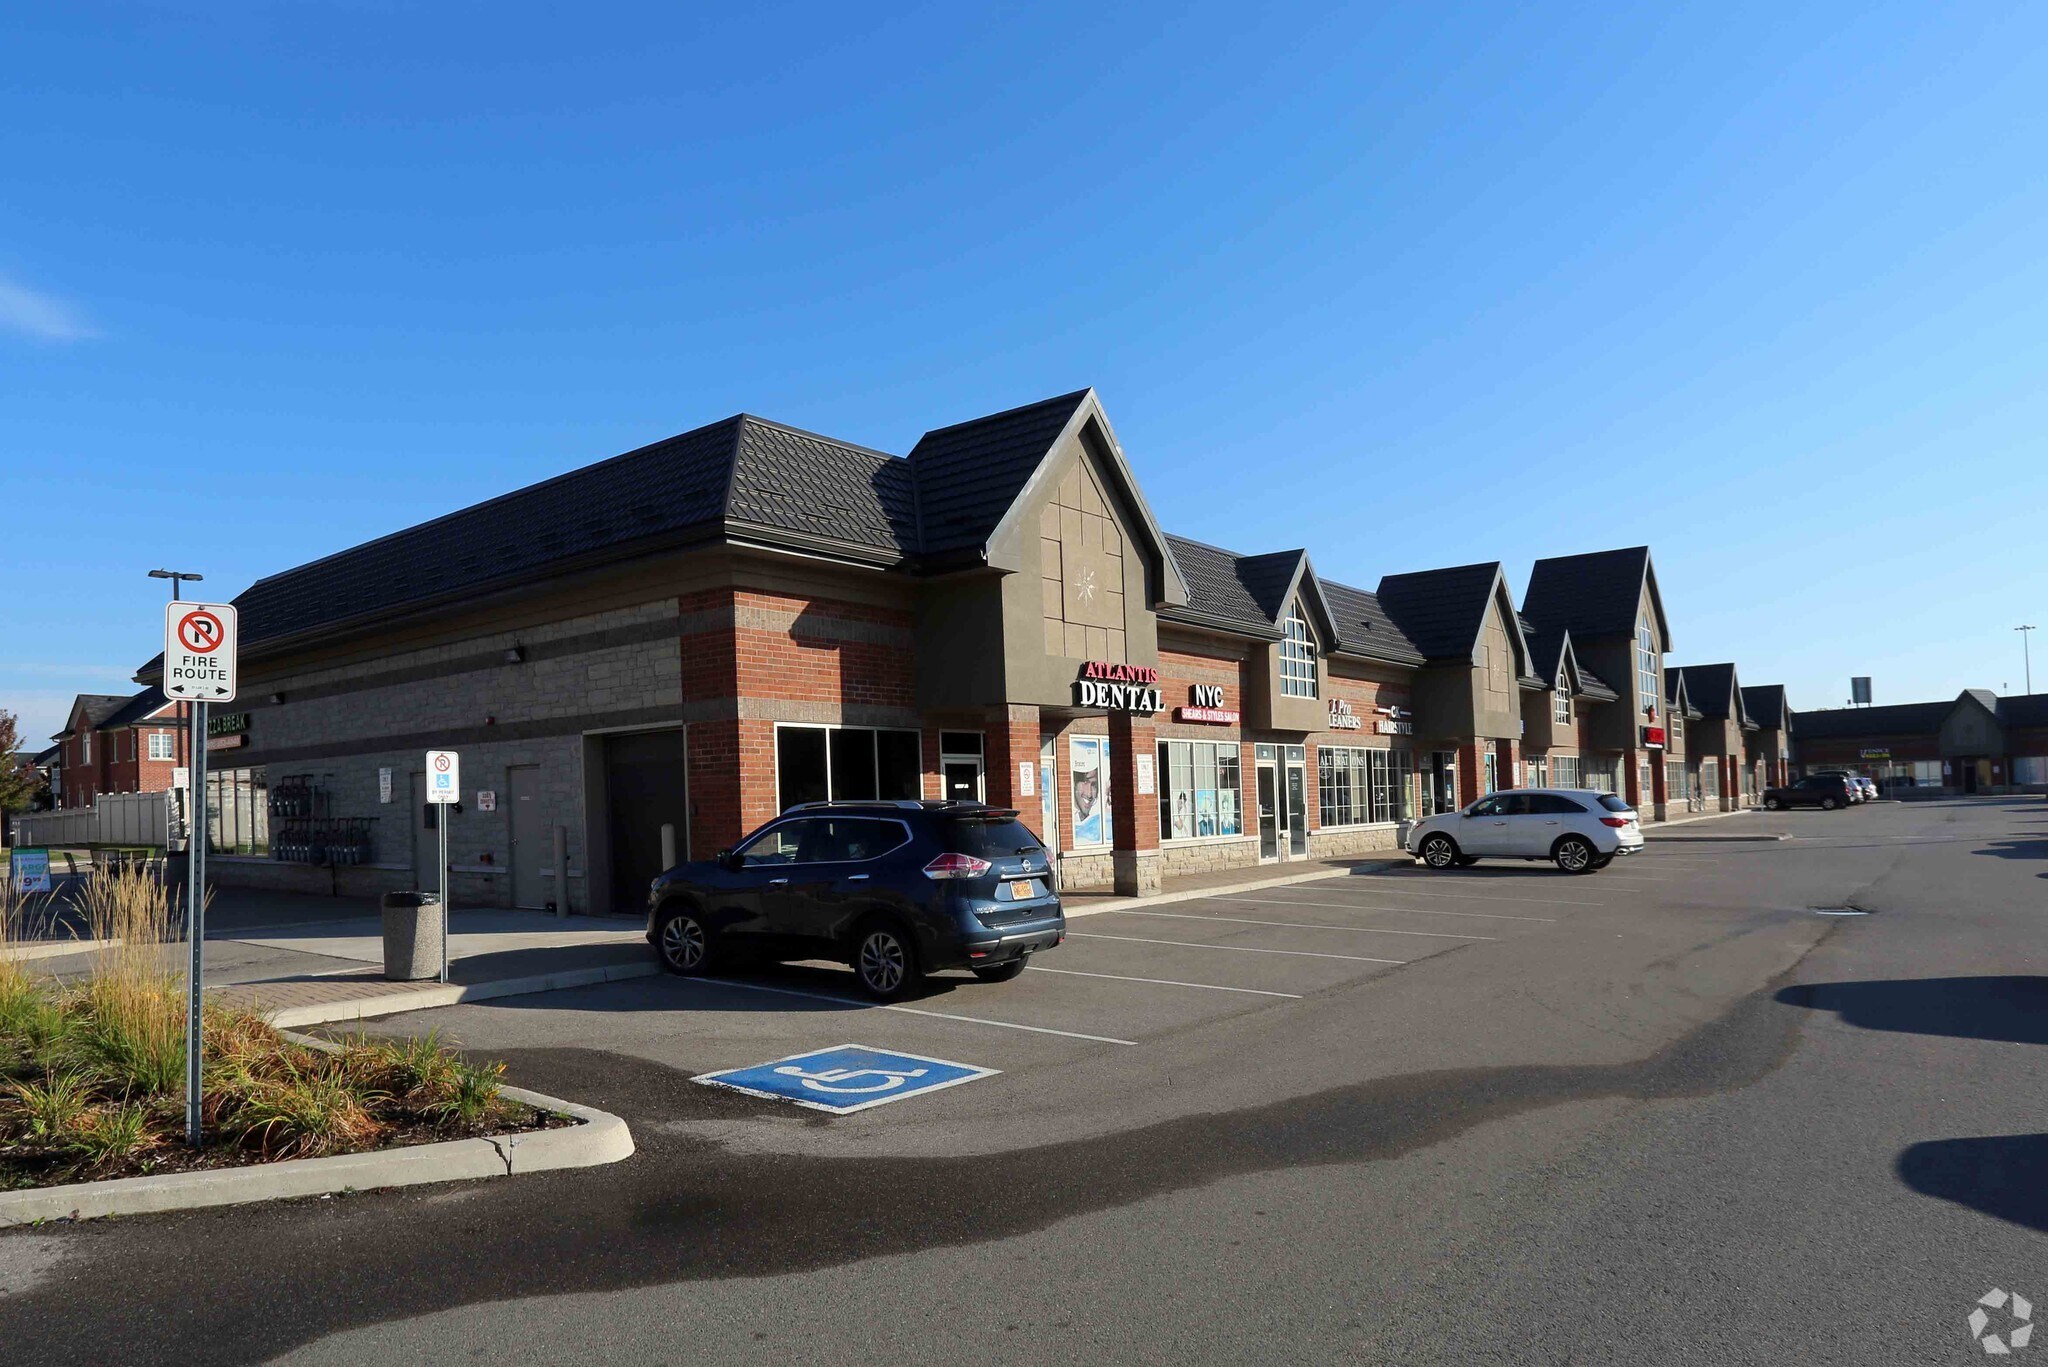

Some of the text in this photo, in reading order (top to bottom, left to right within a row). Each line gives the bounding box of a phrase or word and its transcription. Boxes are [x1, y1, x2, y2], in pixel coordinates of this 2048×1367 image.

[182, 655, 218, 668] FIRE
[173, 667, 227, 680] ROUTE
[1085, 661, 1159, 684] ATLANTIS
[1079, 680, 1167, 713] DENTAL
[1195, 684, 1224, 708] NYC
[1338, 700, 1352, 715] Pro
[223, 713, 246, 732] BREAK
[1181, 708, 1240, 723] SHEARS & STYLES SALON
[1328, 713, 1361, 729] LEANERS
[1378, 720, 1413, 735] HAIRSTYLE
